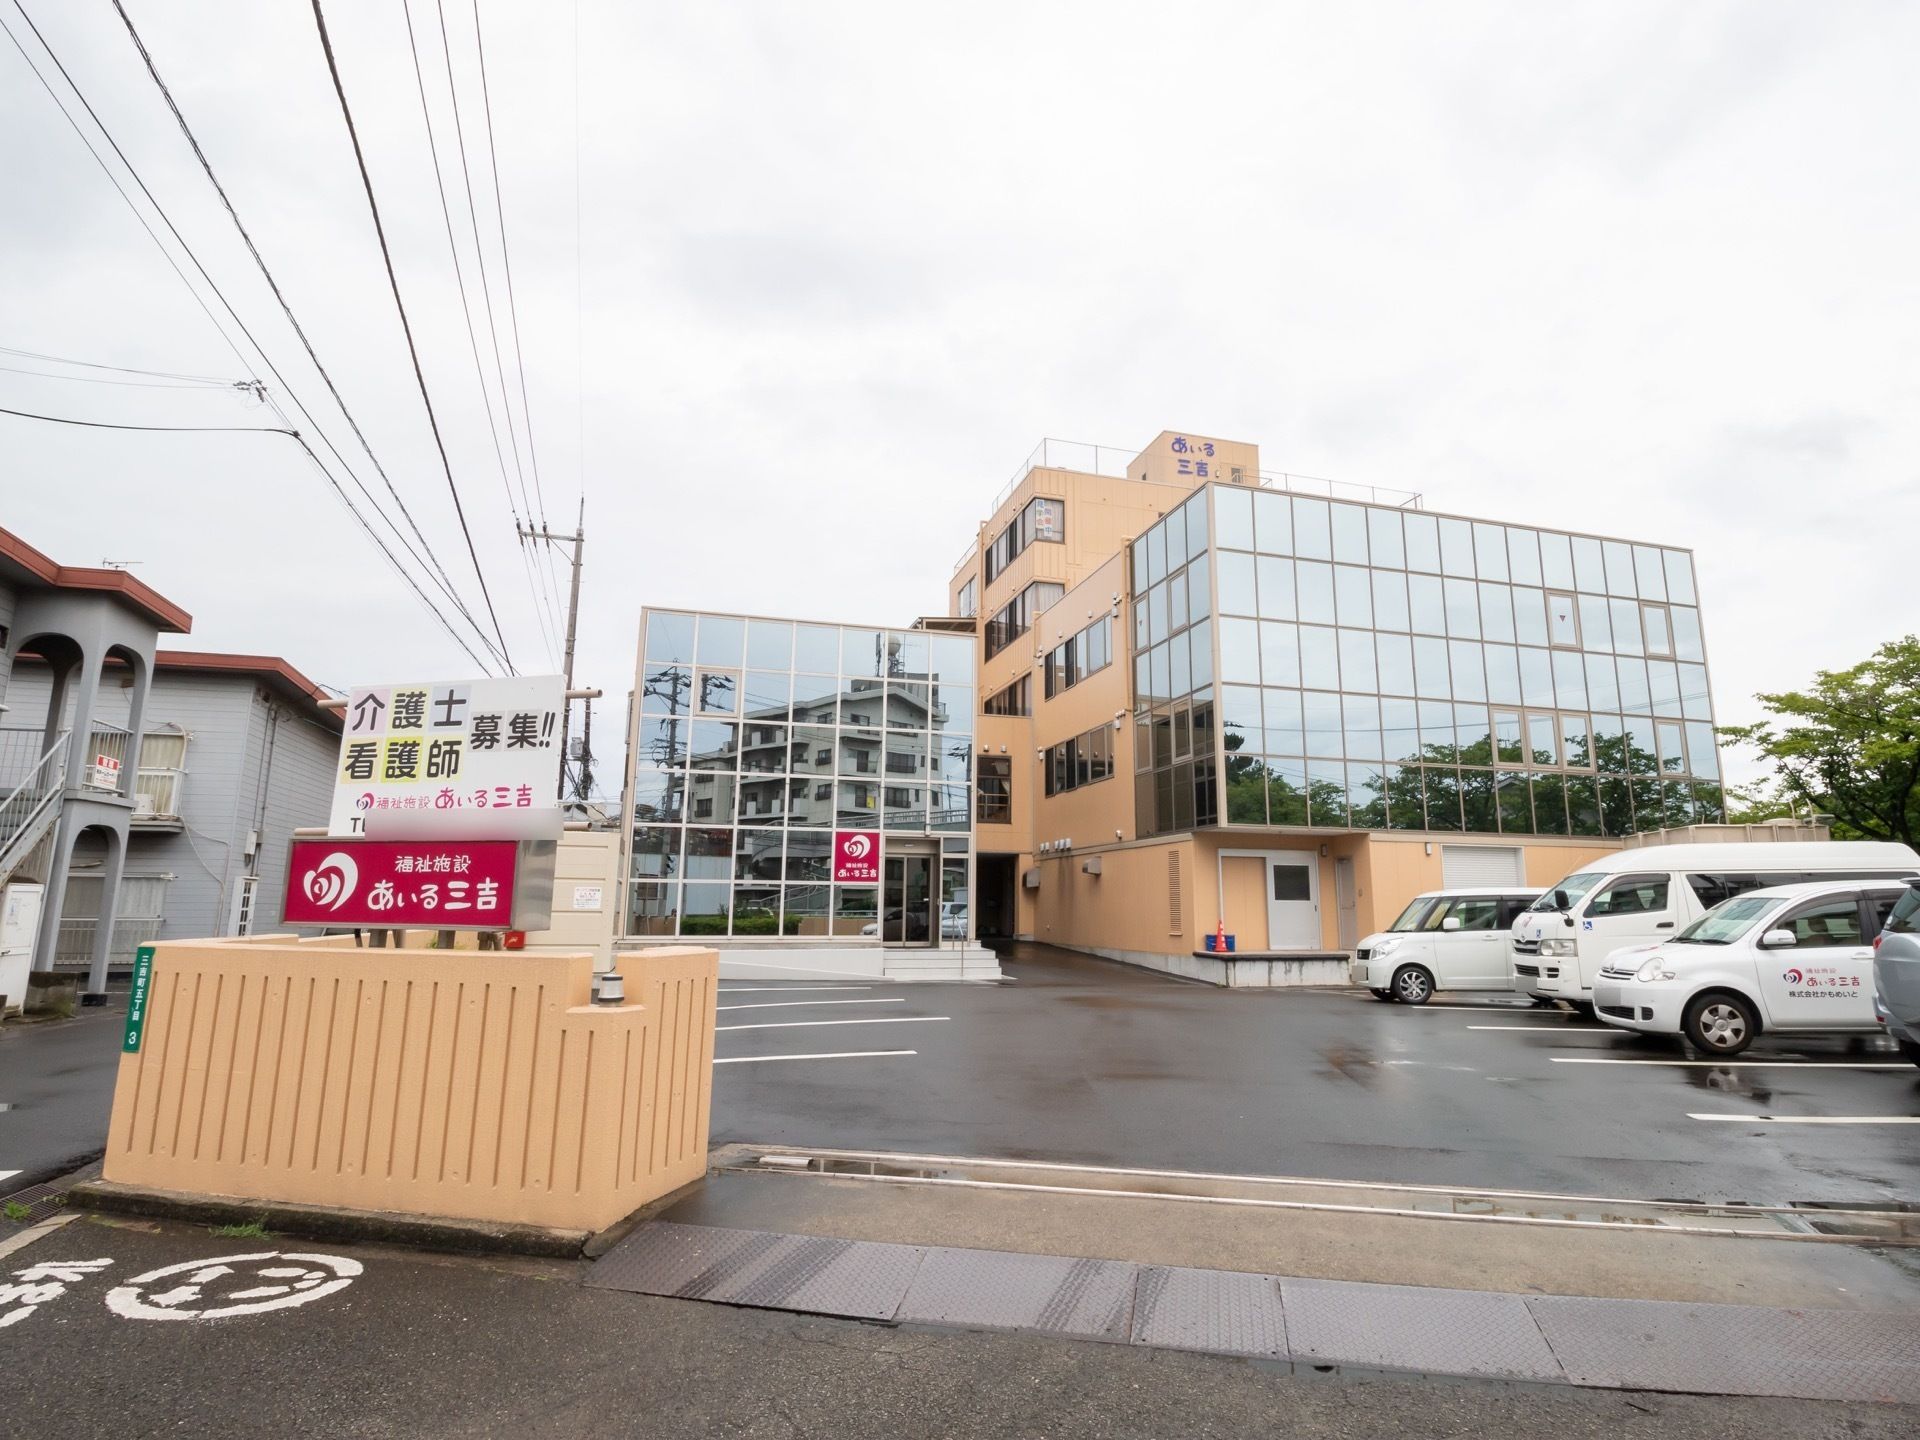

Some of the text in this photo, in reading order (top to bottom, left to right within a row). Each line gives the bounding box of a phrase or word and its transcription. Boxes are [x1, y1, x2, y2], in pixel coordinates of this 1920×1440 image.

[1171, 436, 1215, 457] あいる
[1177, 459, 1208, 477] 三吉
[352, 689, 467, 731] 介護士
[345, 739, 463, 779] 看護師
[434, 784, 533, 809] あいる三吉
[395, 853, 471, 874] 福祉施設
[838, 868, 877, 878] あいる三吉
[367, 877, 499, 911] あいる三吉
[1806, 976, 1860, 987] あいる三吉
[128, 1031, 137, 1045] 3
